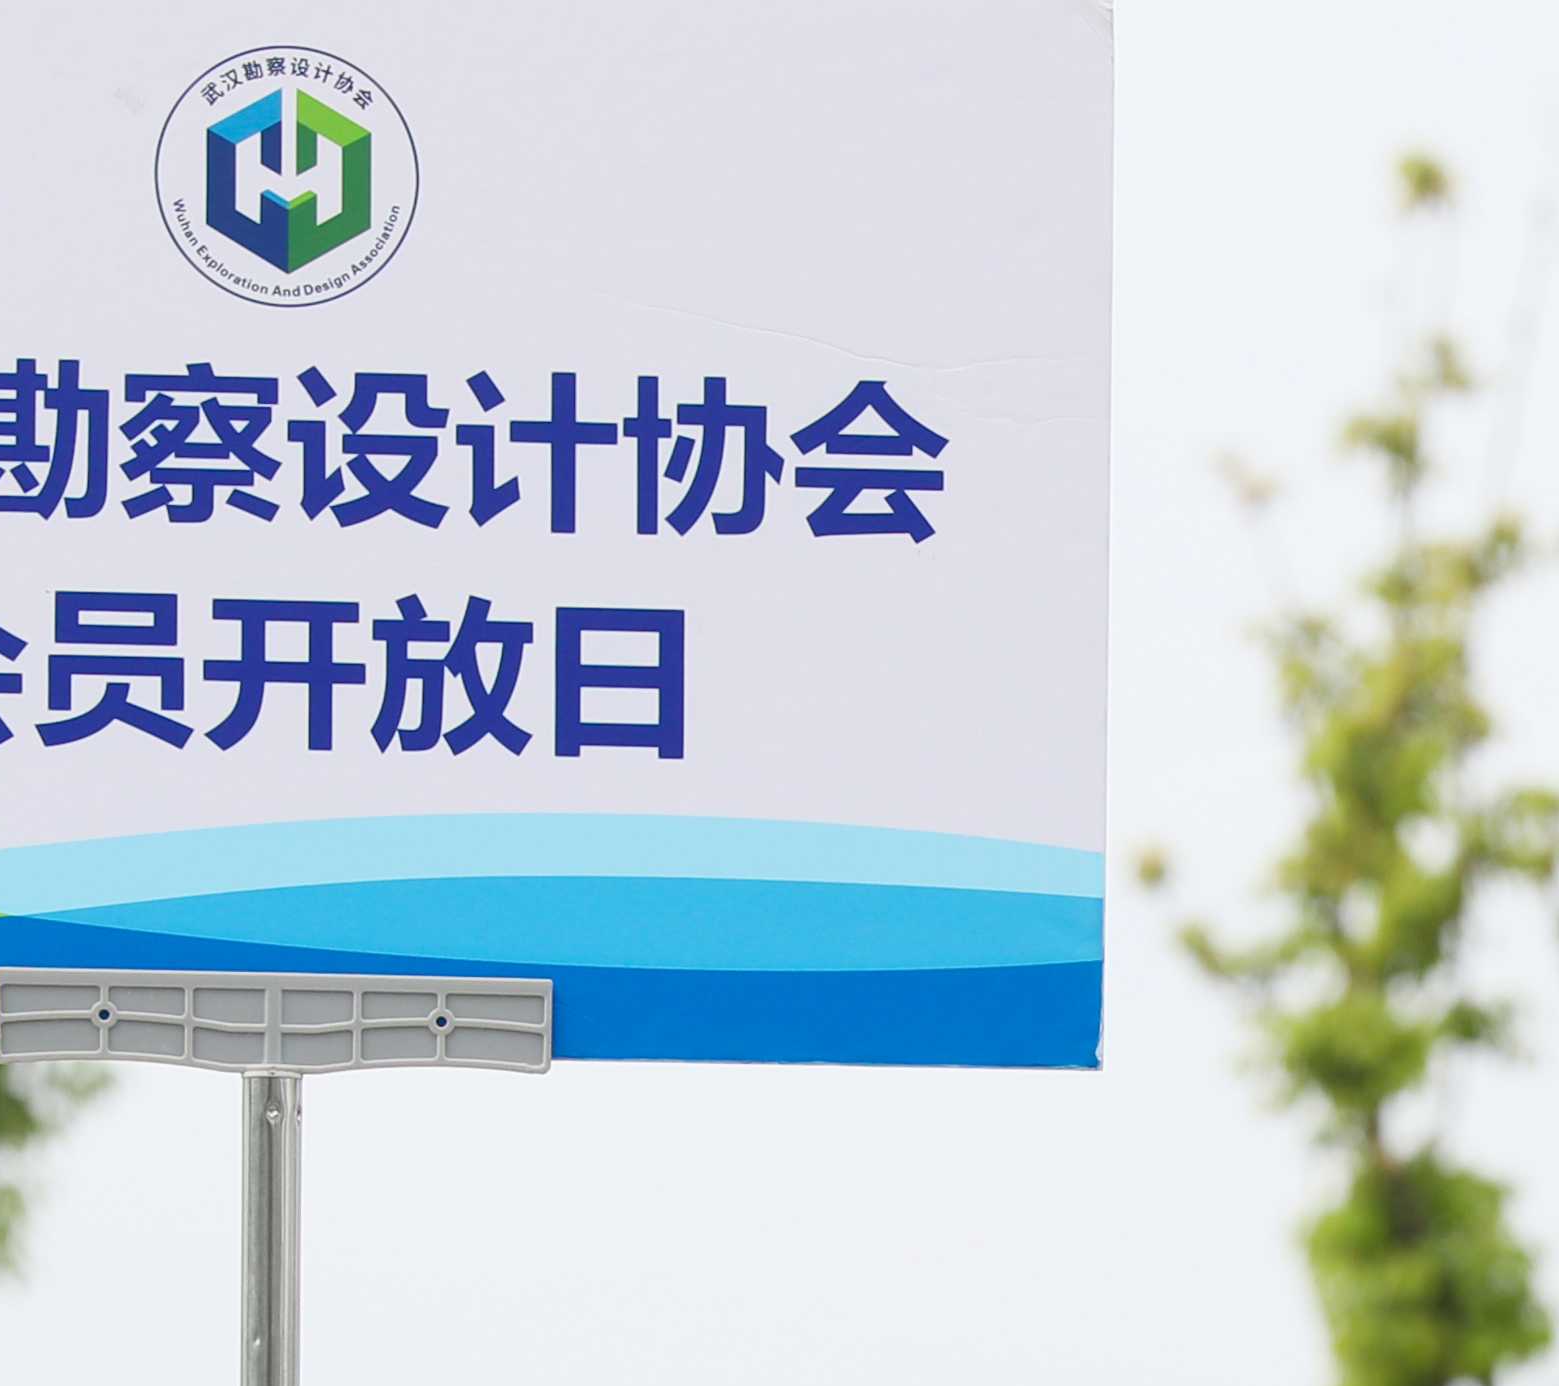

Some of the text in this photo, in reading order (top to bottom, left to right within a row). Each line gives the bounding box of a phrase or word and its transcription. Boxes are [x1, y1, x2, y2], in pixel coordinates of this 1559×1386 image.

[200, 56, 374, 110] 武汉勘察设计协会
[173, 198, 401, 297] Wuhan Exploration And Design Association
